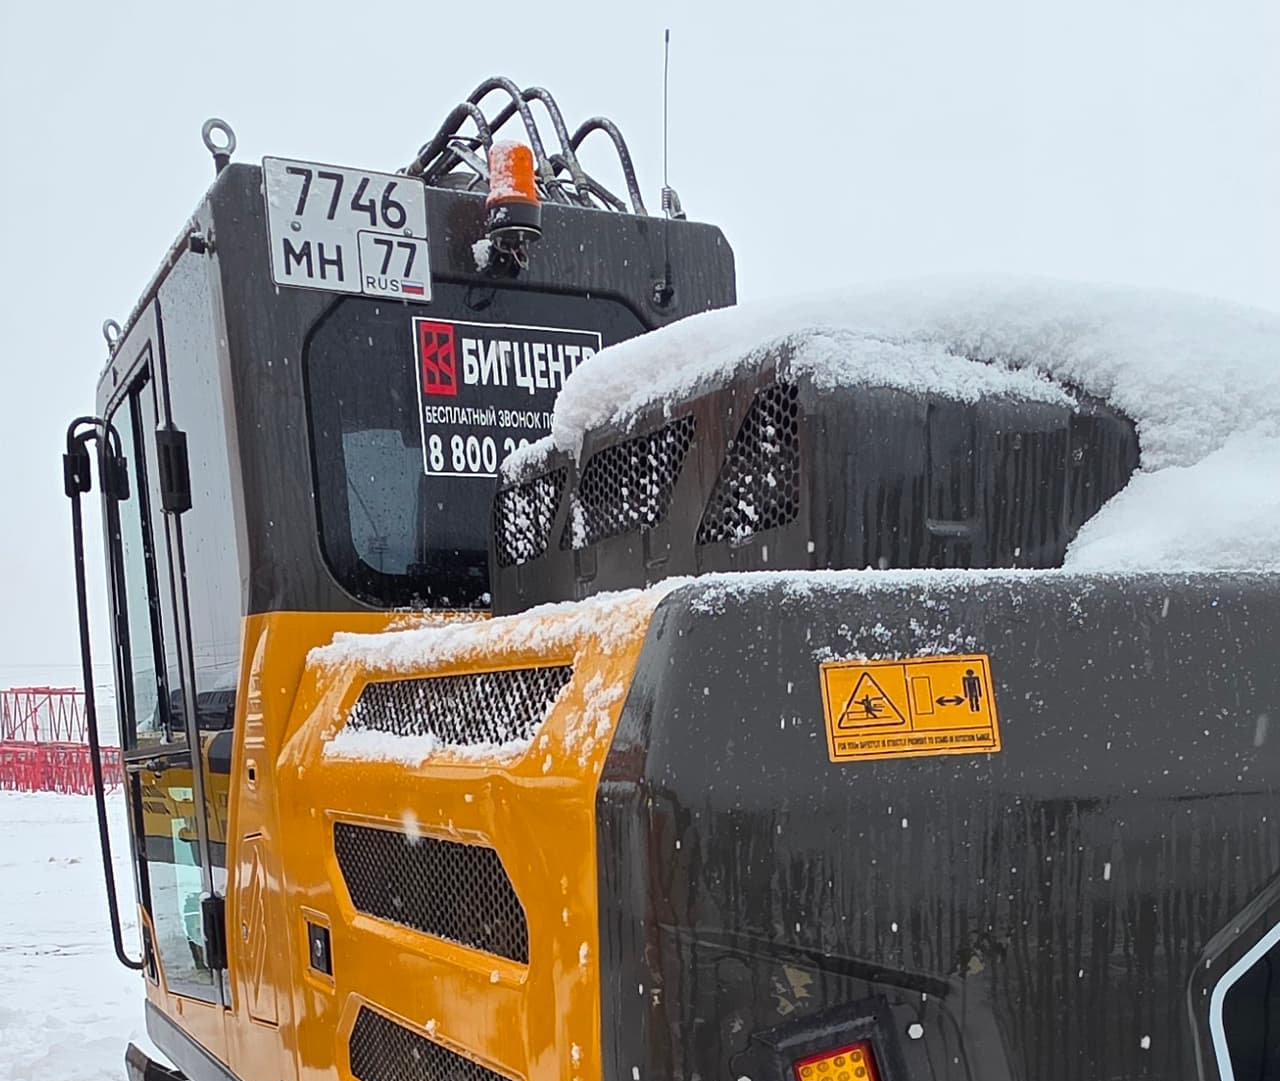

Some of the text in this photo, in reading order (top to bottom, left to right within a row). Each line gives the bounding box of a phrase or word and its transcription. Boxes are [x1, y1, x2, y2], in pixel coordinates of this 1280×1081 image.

[285, 166, 408, 230] 7746
[373, 238, 418, 279] 77
[365, 275, 400, 292] RUS
[424, 404, 497, 427] БЕСПЛАТНЫЙ
[497, 409, 542, 429] ЗВОНОК
[428, 433, 445, 472] 8
[450, 433, 497, 474] 800
